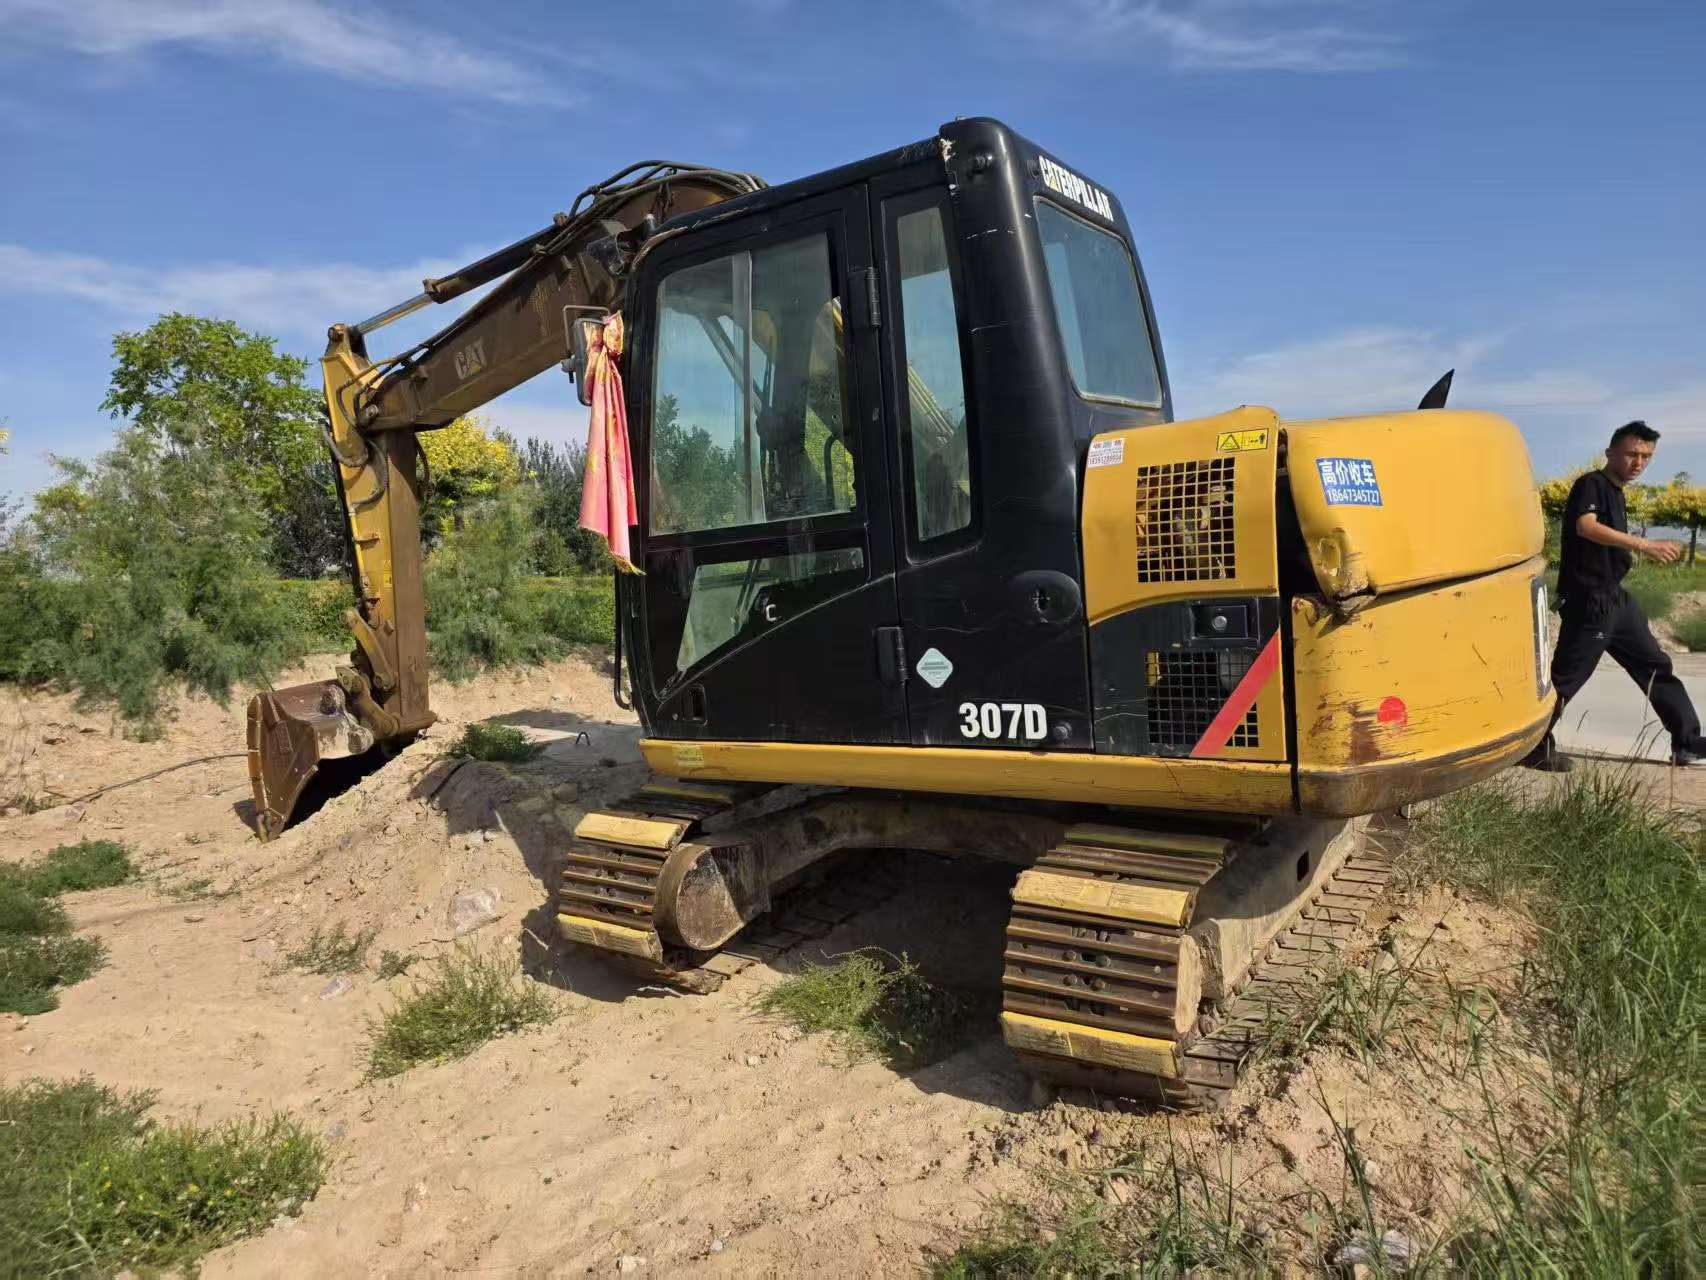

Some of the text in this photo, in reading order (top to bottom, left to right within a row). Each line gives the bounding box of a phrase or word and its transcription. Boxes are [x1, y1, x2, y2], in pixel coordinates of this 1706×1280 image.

[1039, 155, 1114, 222] CATERPILLAR
[455, 337, 487, 380] CAT
[1318, 460, 1376, 487] 高价收车
[958, 702, 1048, 740] 307D
